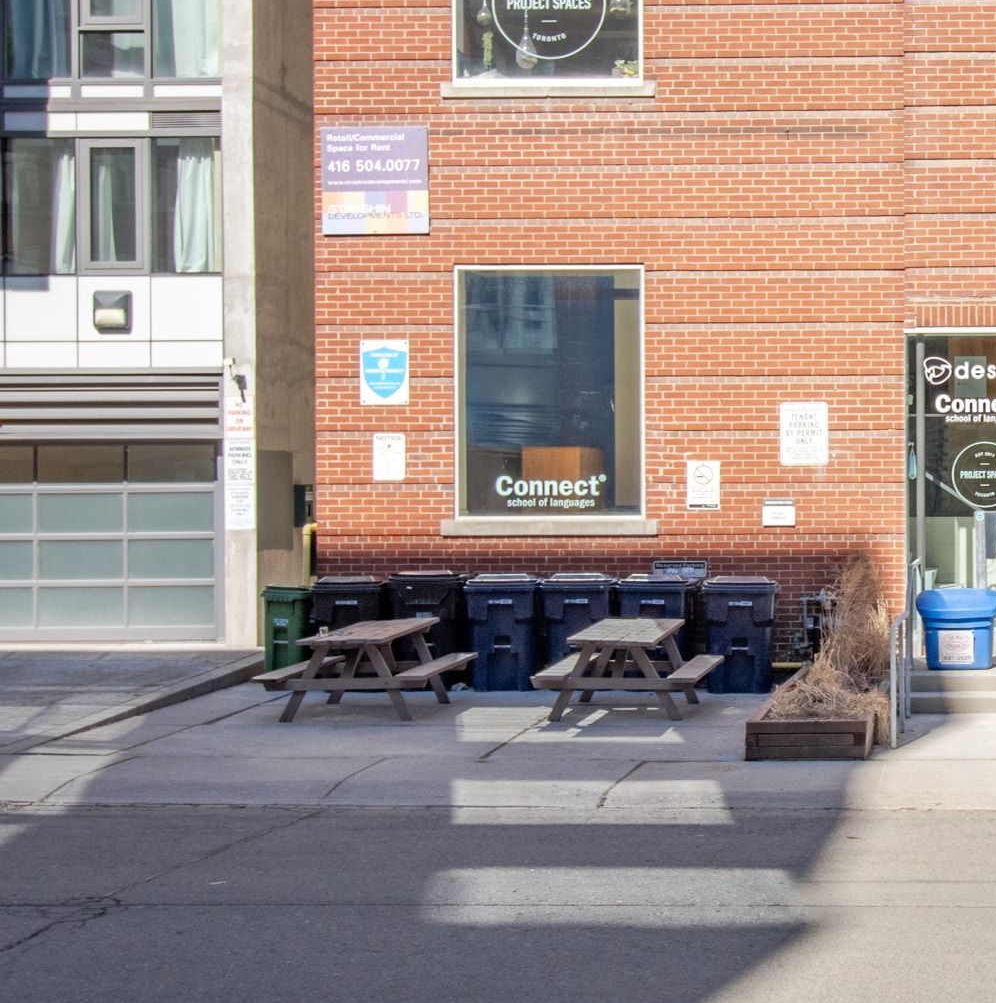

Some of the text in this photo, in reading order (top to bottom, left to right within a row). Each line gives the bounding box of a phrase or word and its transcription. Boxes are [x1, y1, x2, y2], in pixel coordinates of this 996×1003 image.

[532, 32, 567, 42] TORONTO
[326, 133, 405, 142] Retail/Commercial
[327, 144, 353, 153] Space
[328, 159, 420, 172] 416 504.0077
[945, 414, 972, 423] school
[973, 414, 982, 423] of
[789, 421, 820, 429] PARKING
[960, 471, 986, 479] PROJECT
[507, 498, 595, 509] school of languages
